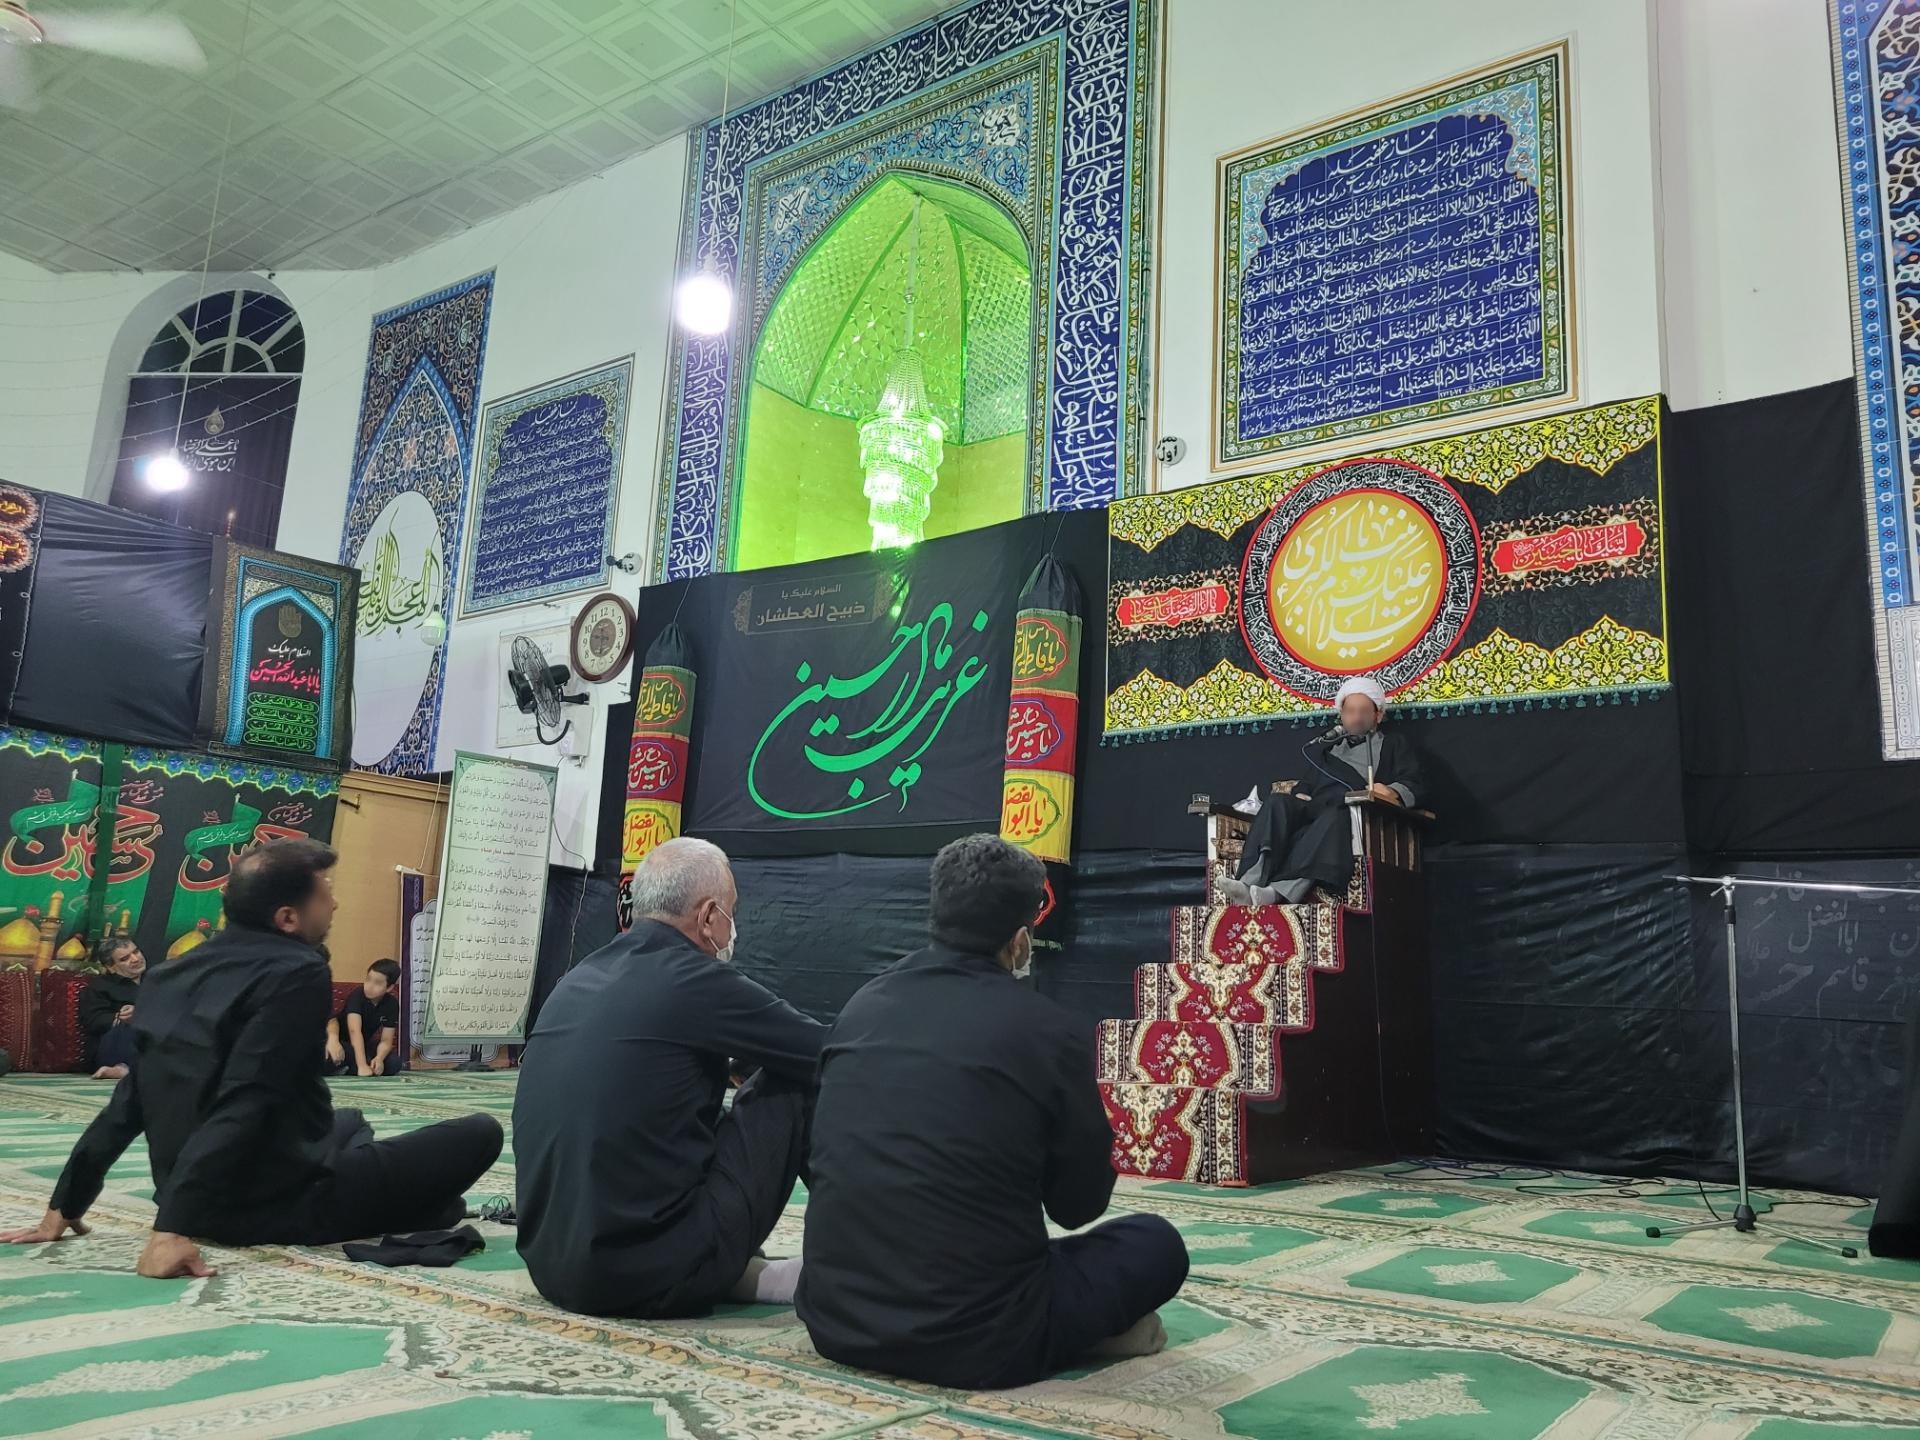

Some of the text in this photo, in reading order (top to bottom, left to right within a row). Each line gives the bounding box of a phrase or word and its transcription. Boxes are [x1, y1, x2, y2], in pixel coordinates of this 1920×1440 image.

[781, 584, 841, 600] السلام علیک یا
[600, 607, 608, 617] 12
[612, 608, 615, 617] 1
[756, 601, 866, 626] ذبیح العطشان
[591, 613, 597, 623] 11
[617, 616, 622, 624] 2
[585, 625, 592, 634] 10
[619, 628, 624, 637] 3
[583, 638, 587, 648] 9
[584, 650, 589, 659] 8
[609, 653, 614, 663] 5
[591, 659, 596, 668] 7
[747, 622, 924, 818] حسین
